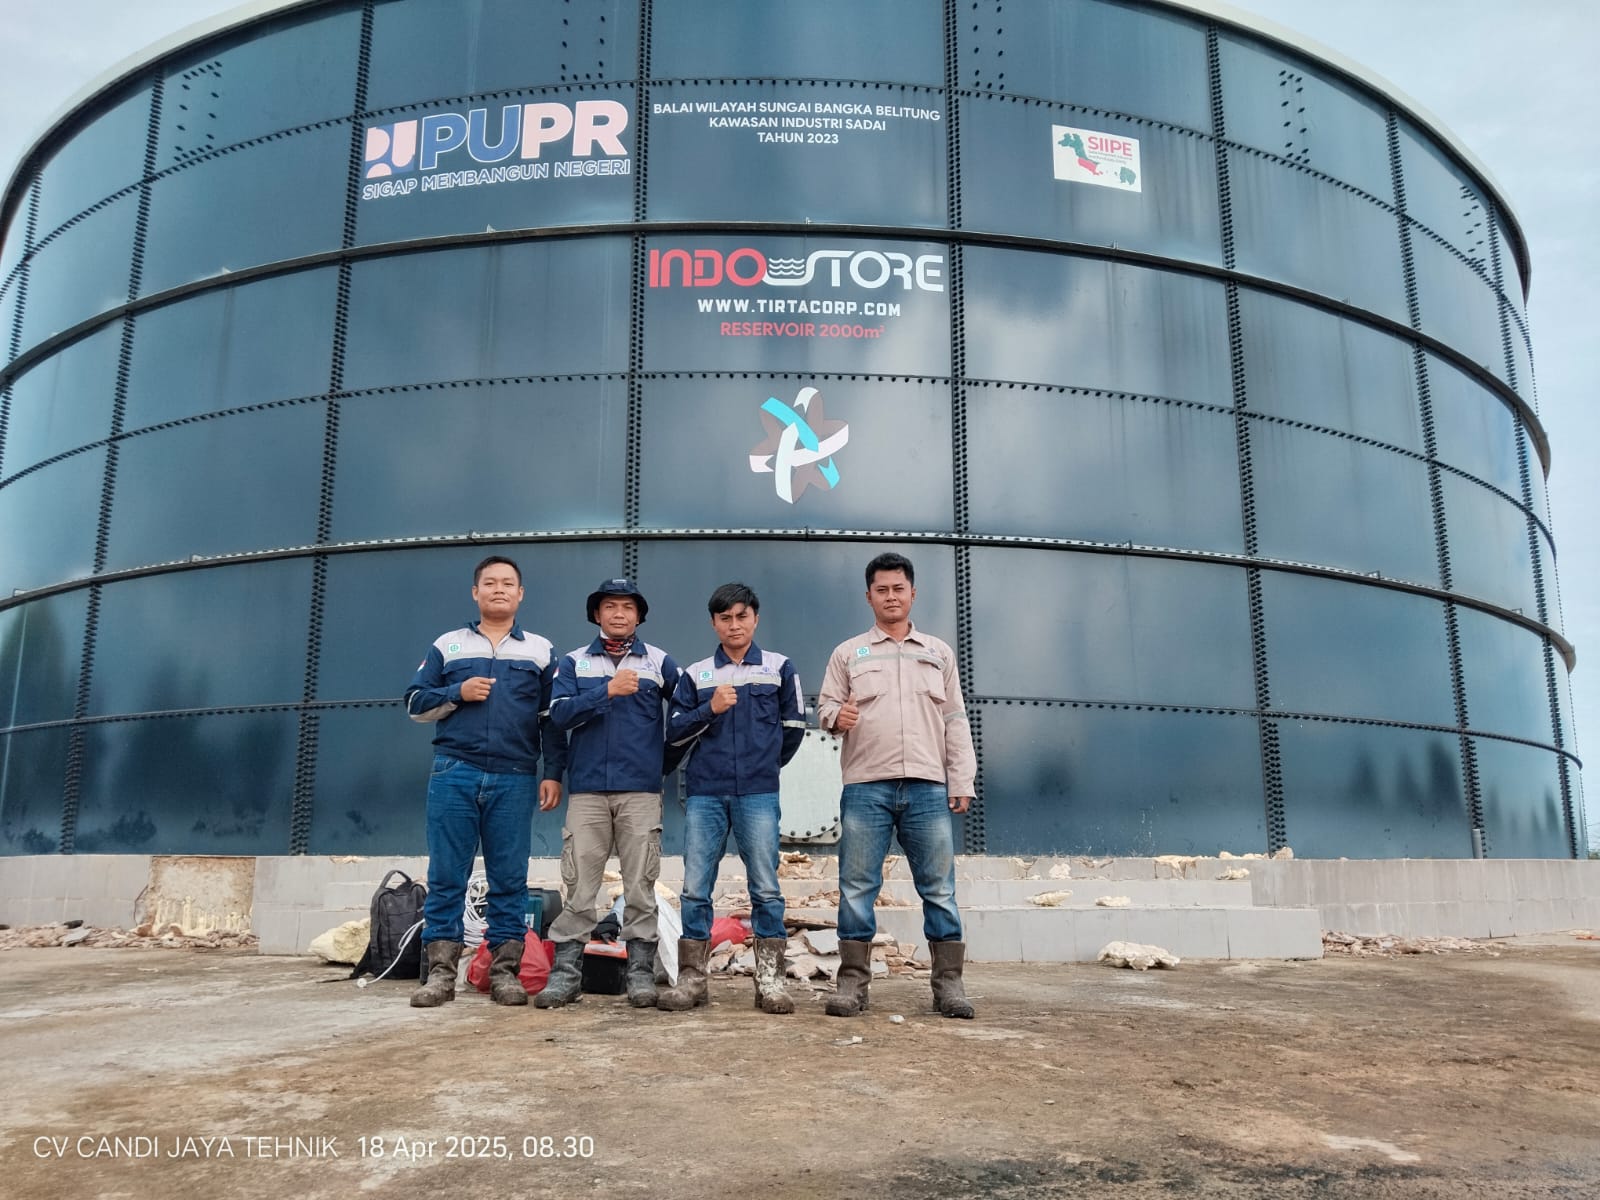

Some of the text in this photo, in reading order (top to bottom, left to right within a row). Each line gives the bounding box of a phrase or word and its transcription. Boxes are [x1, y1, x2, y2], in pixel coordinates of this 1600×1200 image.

[653, 102, 941, 121] BALAI WILAYAH SUNGAI BANGKA BELITUNG
[709, 117, 886, 131] KAWASAN INDUSTRI SADAI
[419, 100, 629, 170] PUPR
[757, 132, 839, 144] TAHUN 2023
[1087, 136, 1133, 157] SIIPE
[362, 159, 631, 200] SIGAP MEMBANGUN NEGERI
[697, 299, 901, 317] WWW.TIRTACORP.COM
[720, 322, 815, 337] RESERVOIR
